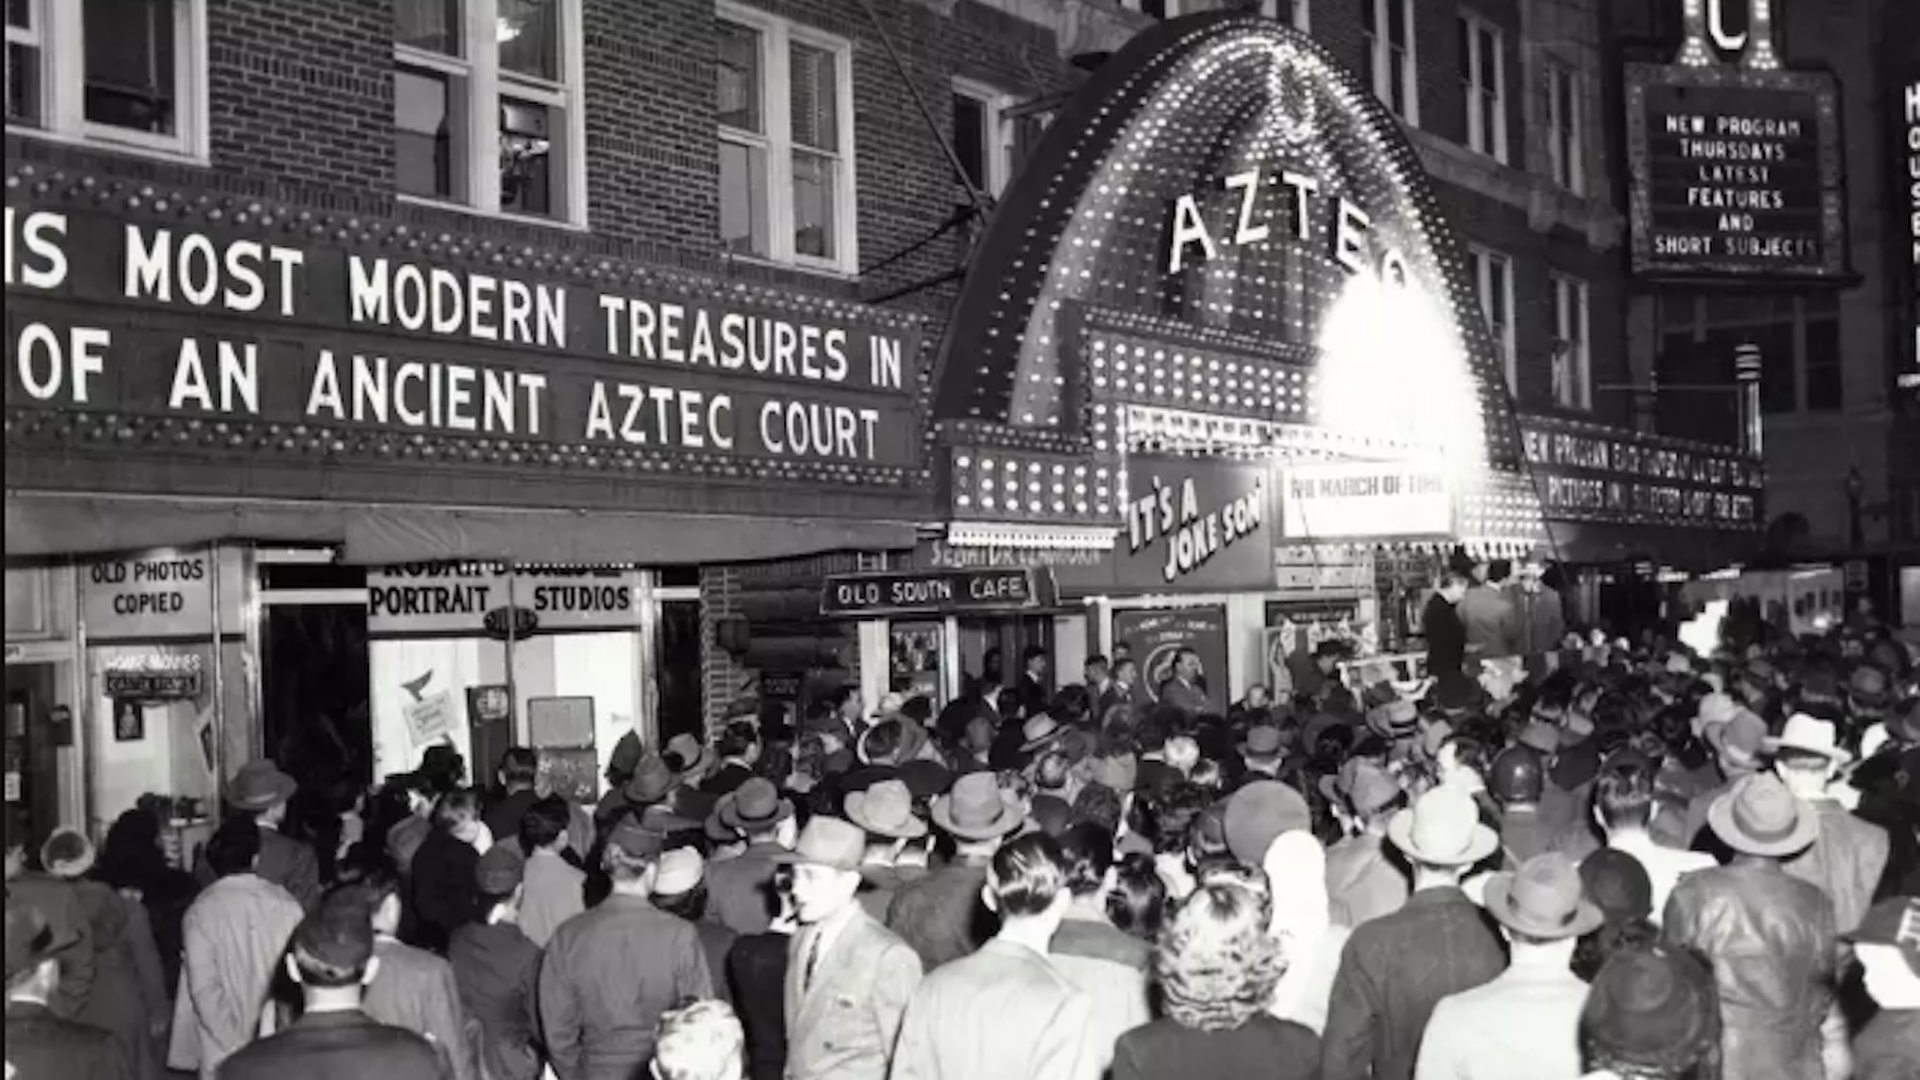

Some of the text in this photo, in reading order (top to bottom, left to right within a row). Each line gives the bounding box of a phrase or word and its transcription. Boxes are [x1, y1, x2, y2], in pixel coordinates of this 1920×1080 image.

[1666, 115, 1800, 136] NEW PROGRAM
[1680, 138, 1785, 161] THURSDAYS
[1699, 165, 1768, 184] LATEST
[1688, 187, 1783, 209] FEATURES
[1718, 213, 1754, 231] AND
[1655, 235, 1816, 256] SHORT SUBJECTS
[125, 225, 303, 316] MOST
[349, 256, 567, 349] MODERN
[599, 294, 849, 383] TREASURES
[870, 335, 902, 389] IN
[18, 322, 880, 460] OF AN ANCIENT AZTEC COURT
[1319, 476, 1378, 498] MARCH
[1382, 475, 1402, 496] OF
[1129, 475, 1199, 550] IT'S A
[1163, 512, 1217, 581] JOKE
[92, 558, 204, 583] OLD PHOTOS
[368, 584, 630, 616] PORTRAIT STUDIOS
[837, 577, 1024, 604] OLD SOUTH CAFE
[113, 591, 184, 615] COPIED
